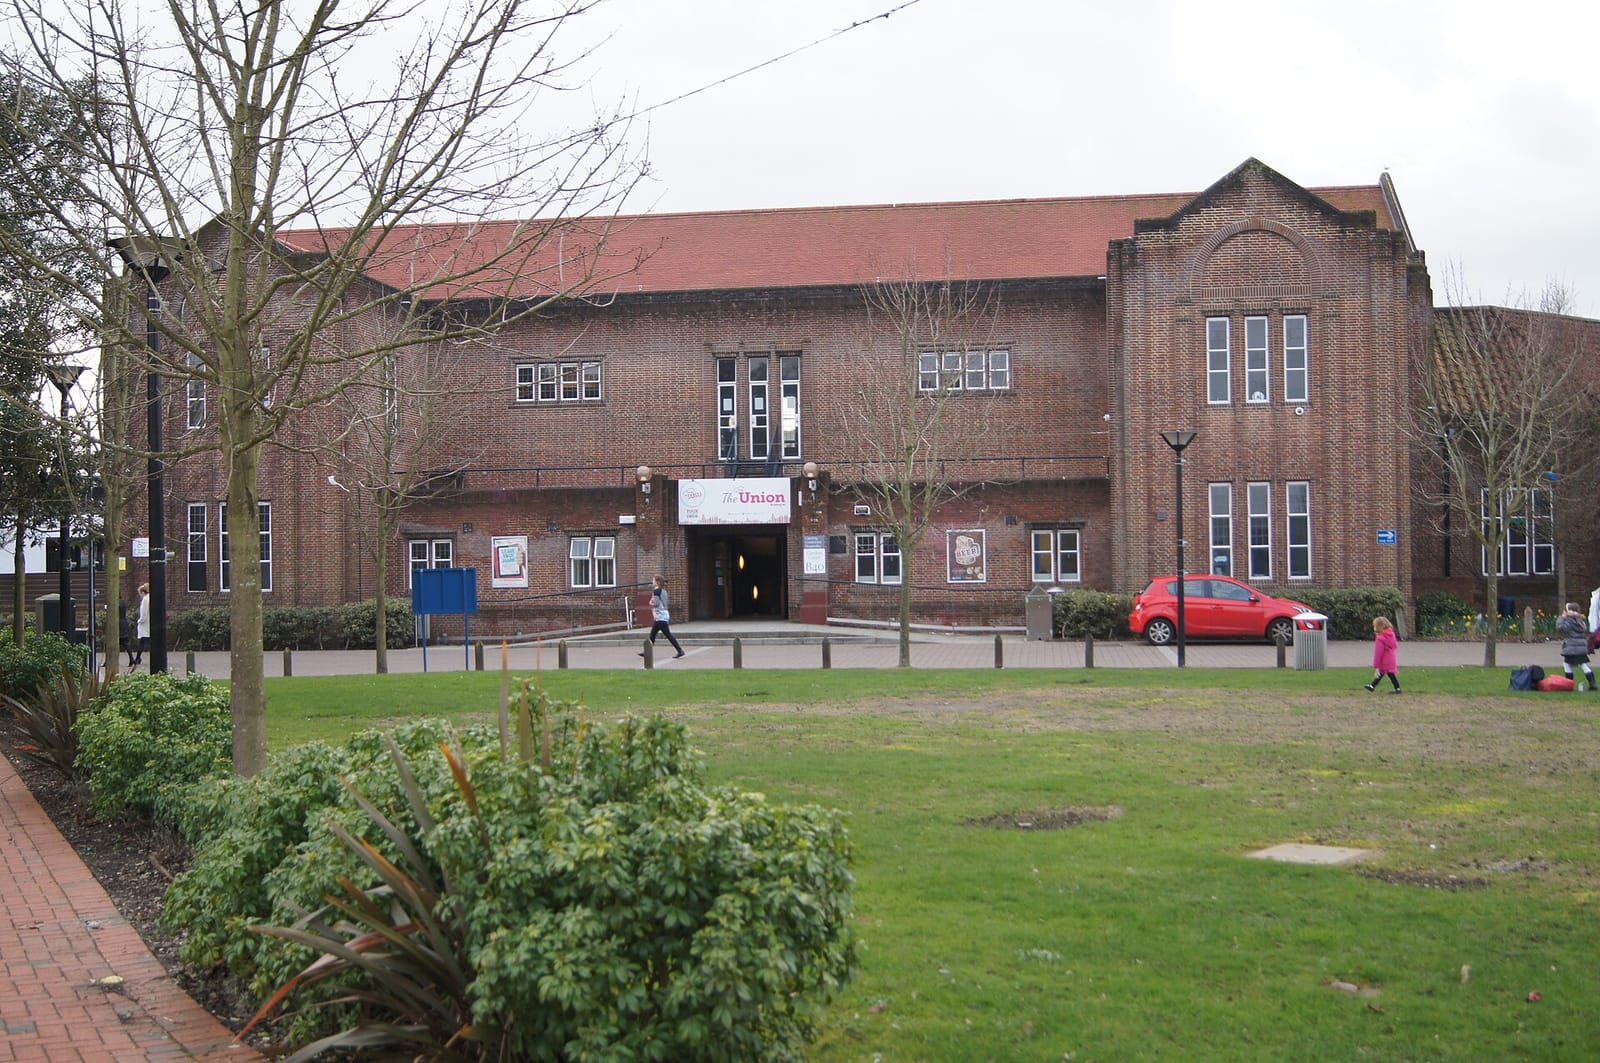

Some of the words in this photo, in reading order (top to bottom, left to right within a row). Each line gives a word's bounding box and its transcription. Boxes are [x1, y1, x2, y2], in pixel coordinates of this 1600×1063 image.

[722, 492, 738, 504] The
[739, 491, 786, 503] Union
[957, 548, 977, 557] BEER
